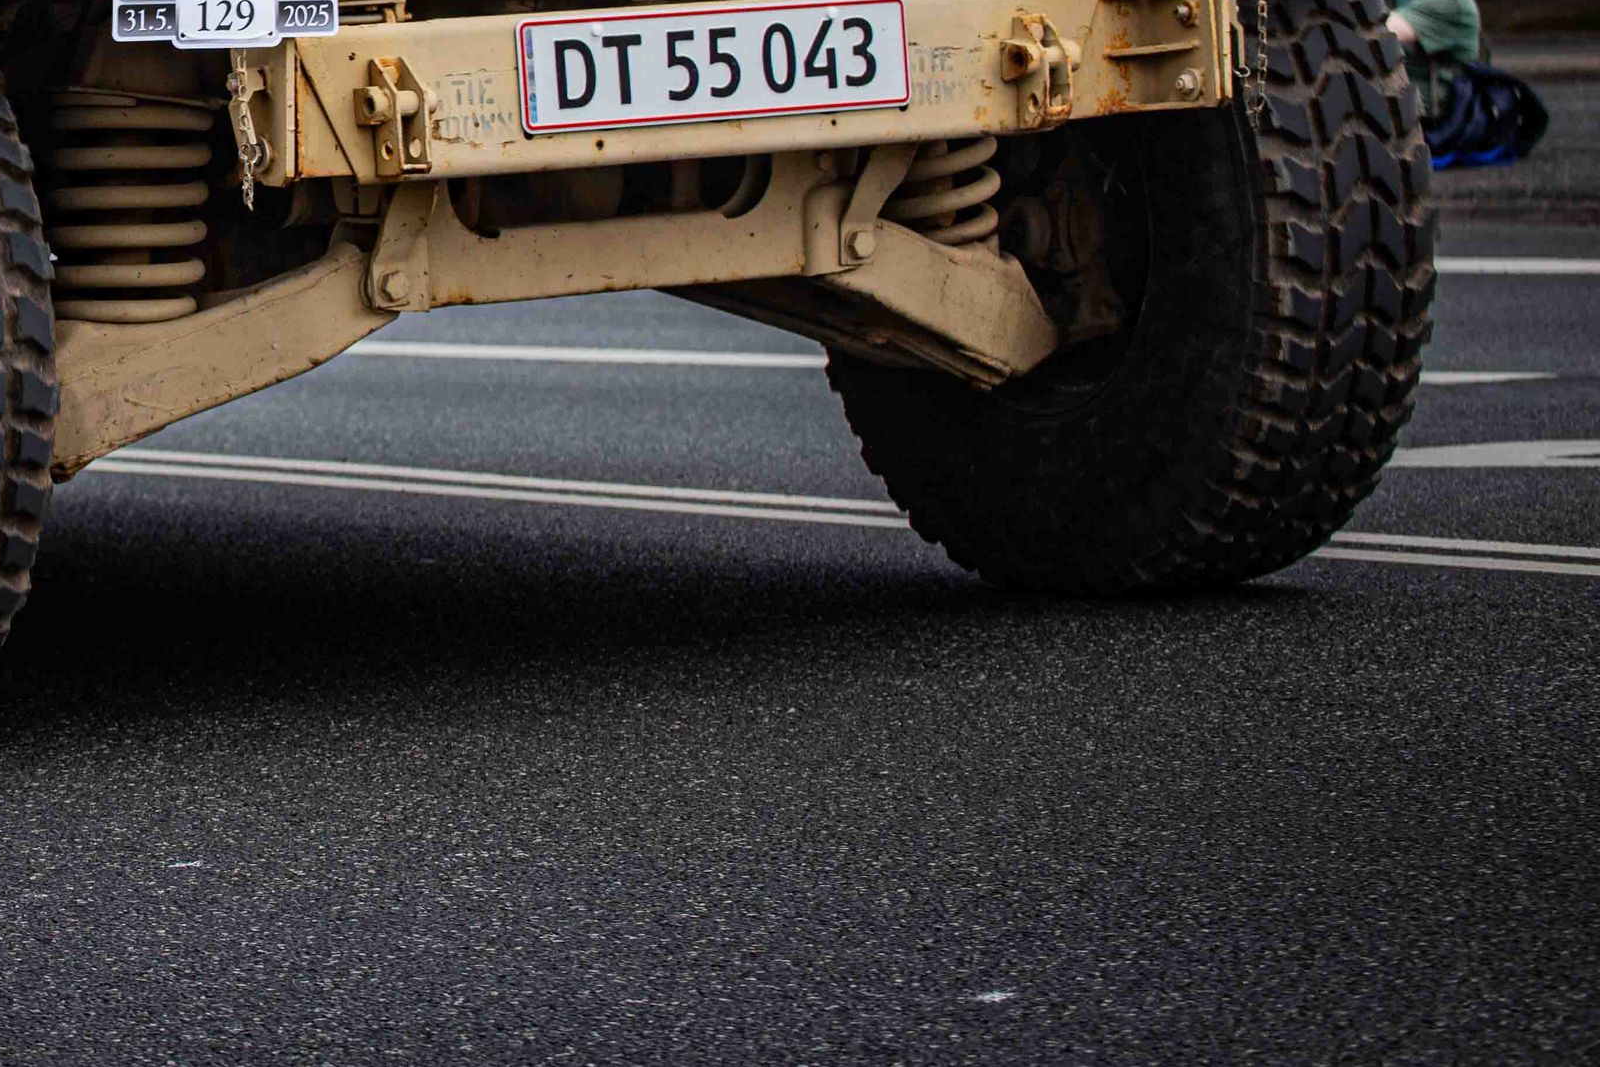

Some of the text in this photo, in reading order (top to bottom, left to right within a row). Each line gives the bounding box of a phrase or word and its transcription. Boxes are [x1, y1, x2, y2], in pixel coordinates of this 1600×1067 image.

[124, 0, 330, 32] 31.5. 129 2025
[554, 17, 877, 110] DT 55 043
